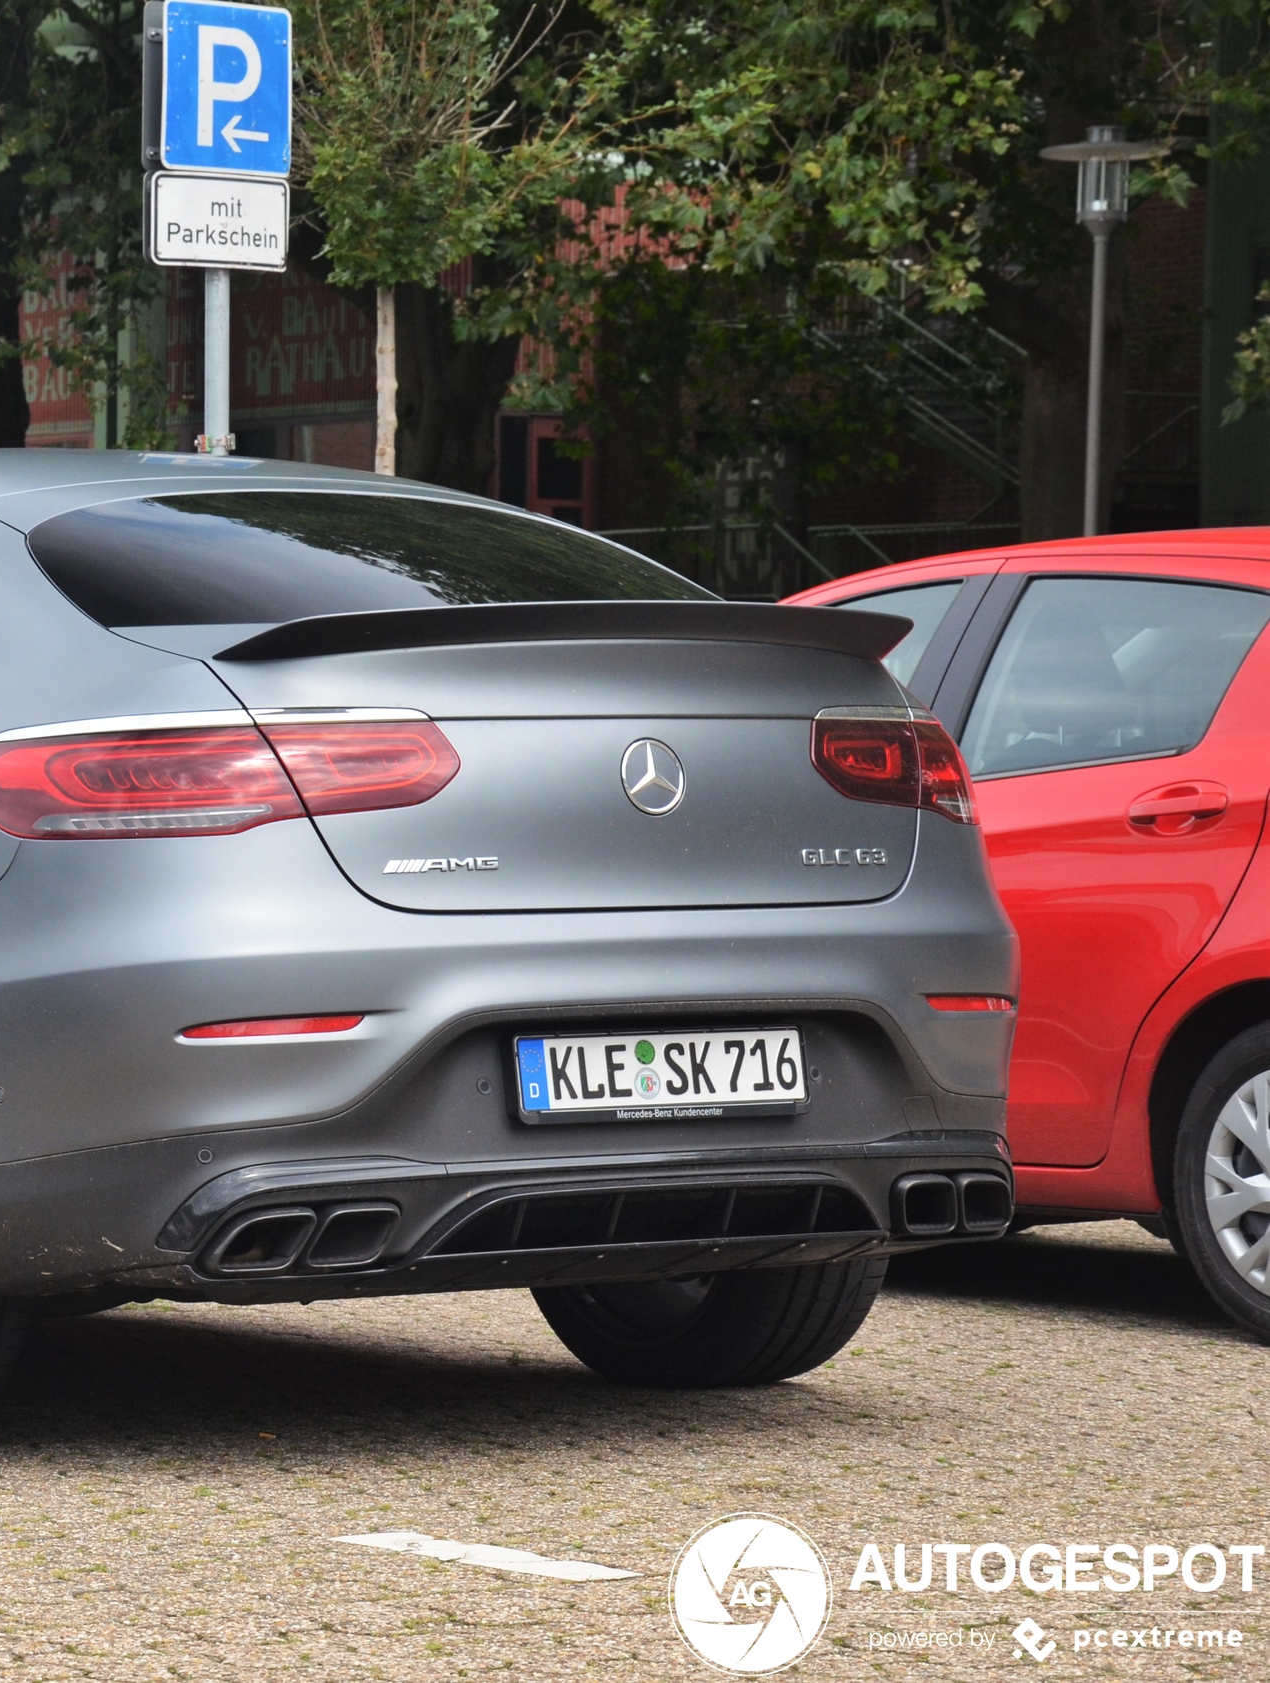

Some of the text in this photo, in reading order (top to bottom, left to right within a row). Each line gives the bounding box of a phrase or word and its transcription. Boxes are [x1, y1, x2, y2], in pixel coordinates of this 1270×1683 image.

[197, 25, 262, 147] P
[211, 198, 242, 218] mit
[167, 222, 279, 249] Parkschein
[420, 856, 499, 872] AMG
[802, 849, 887, 866] GLC 63
[549, 1043, 633, 1100] KLE
[663, 1040, 716, 1096] SK
[723, 1037, 798, 1093] 716
[530, 1083, 540, 1098] D
[616, 1106, 723, 1120] Mercedes-Benz Kundencenter
